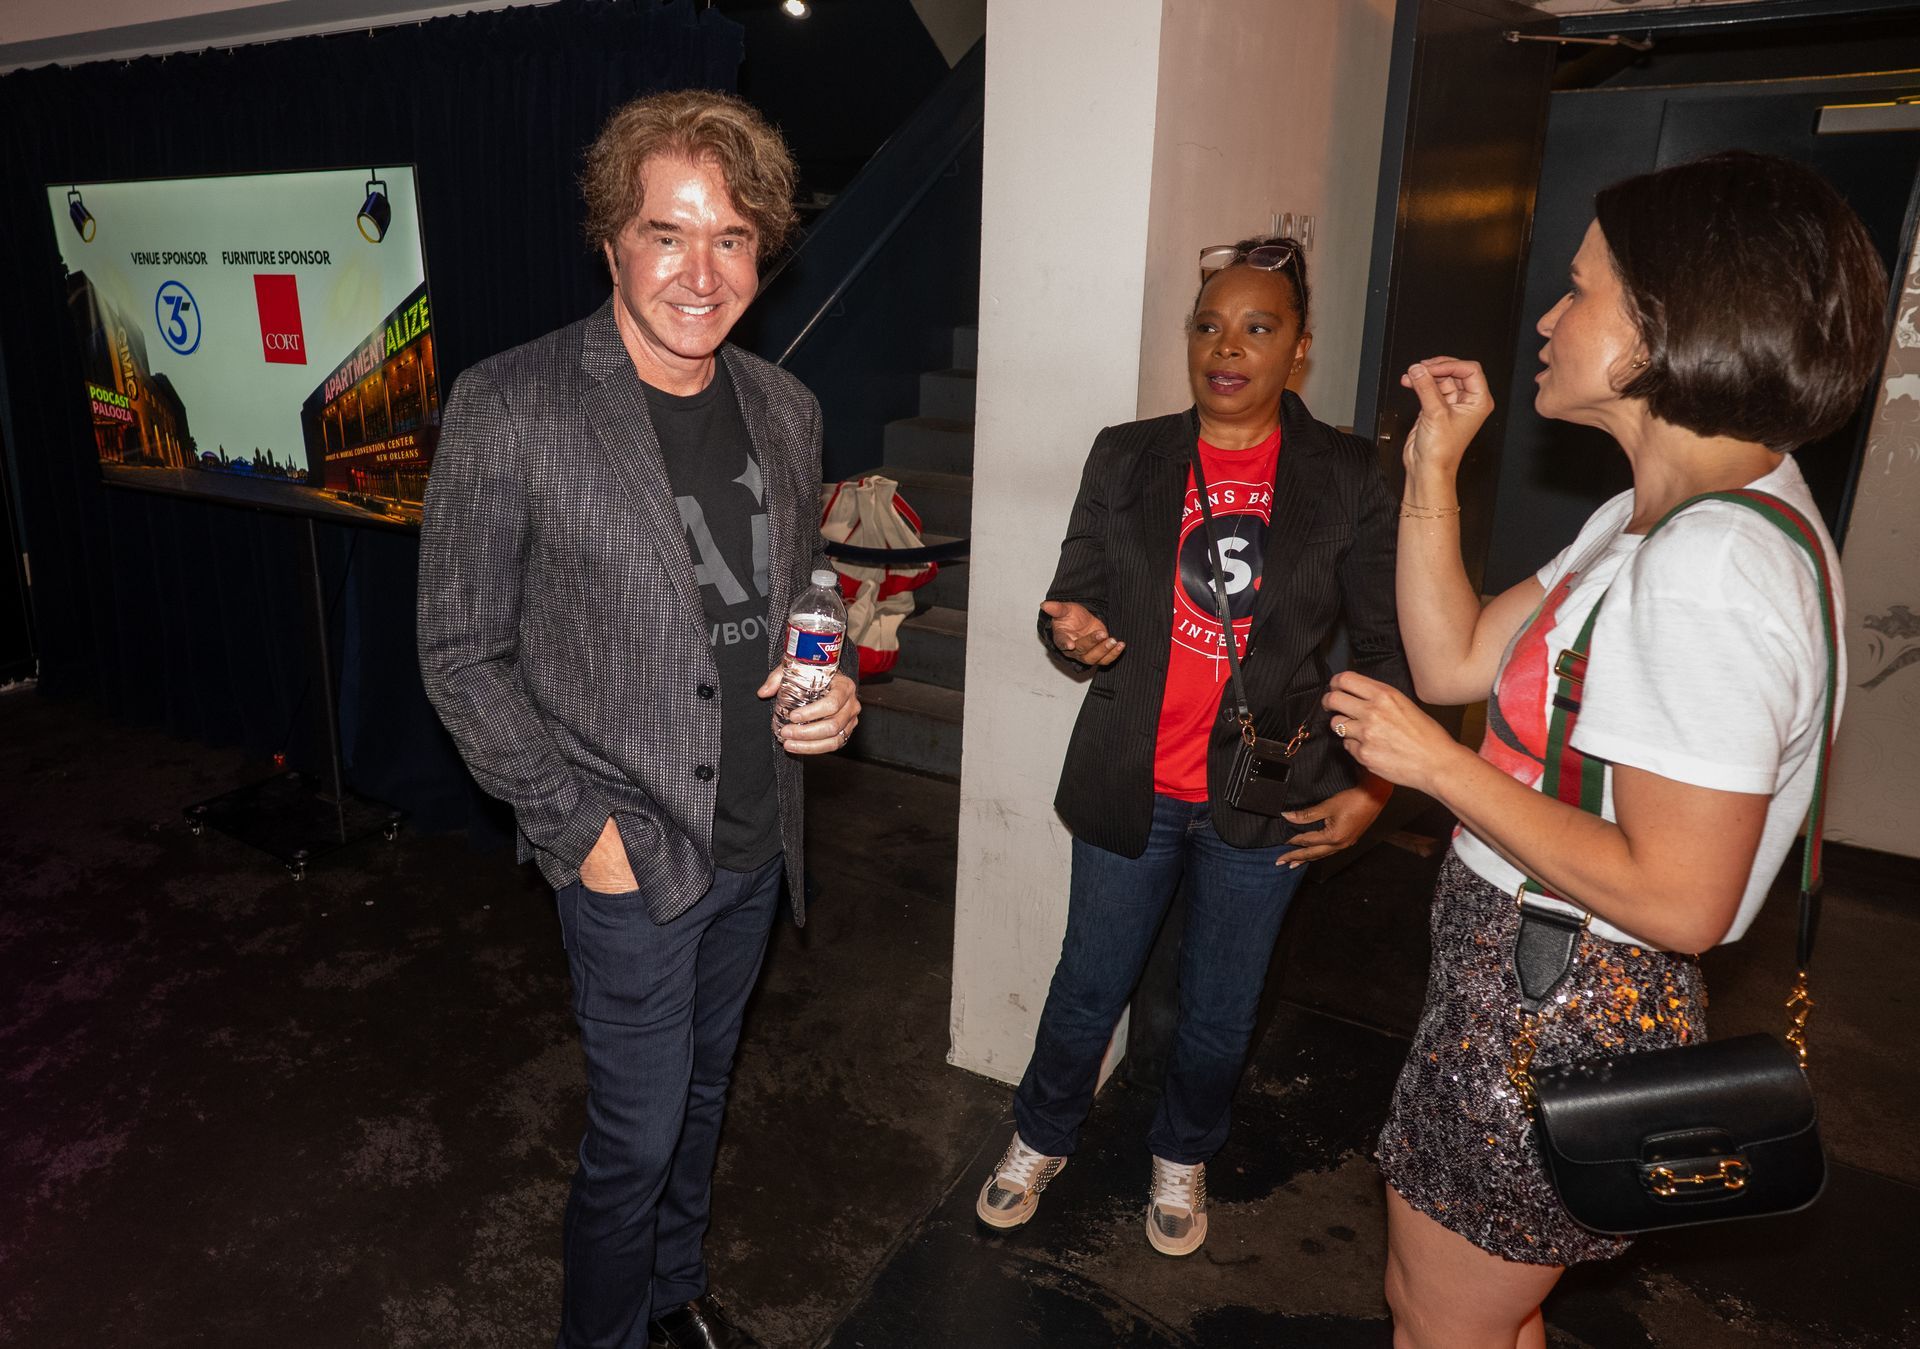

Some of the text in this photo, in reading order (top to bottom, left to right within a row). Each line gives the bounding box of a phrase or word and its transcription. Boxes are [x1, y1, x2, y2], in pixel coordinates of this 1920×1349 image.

[131, 252, 208, 265] VENUE SPONSOR
[222, 250, 331, 265] FURNITURE SPONSOR
[266, 333, 299, 350] CORT
[89, 385, 129, 409] PODCAST
[92, 400, 133, 422] PALOOZA
[355, 442, 386, 456] CONVENTION
[387, 435, 414, 449] CENTER
[389, 448, 419, 460] ORLEANS
[1248, 491, 1272, 513] BE
[1207, 536, 1252, 596] S
